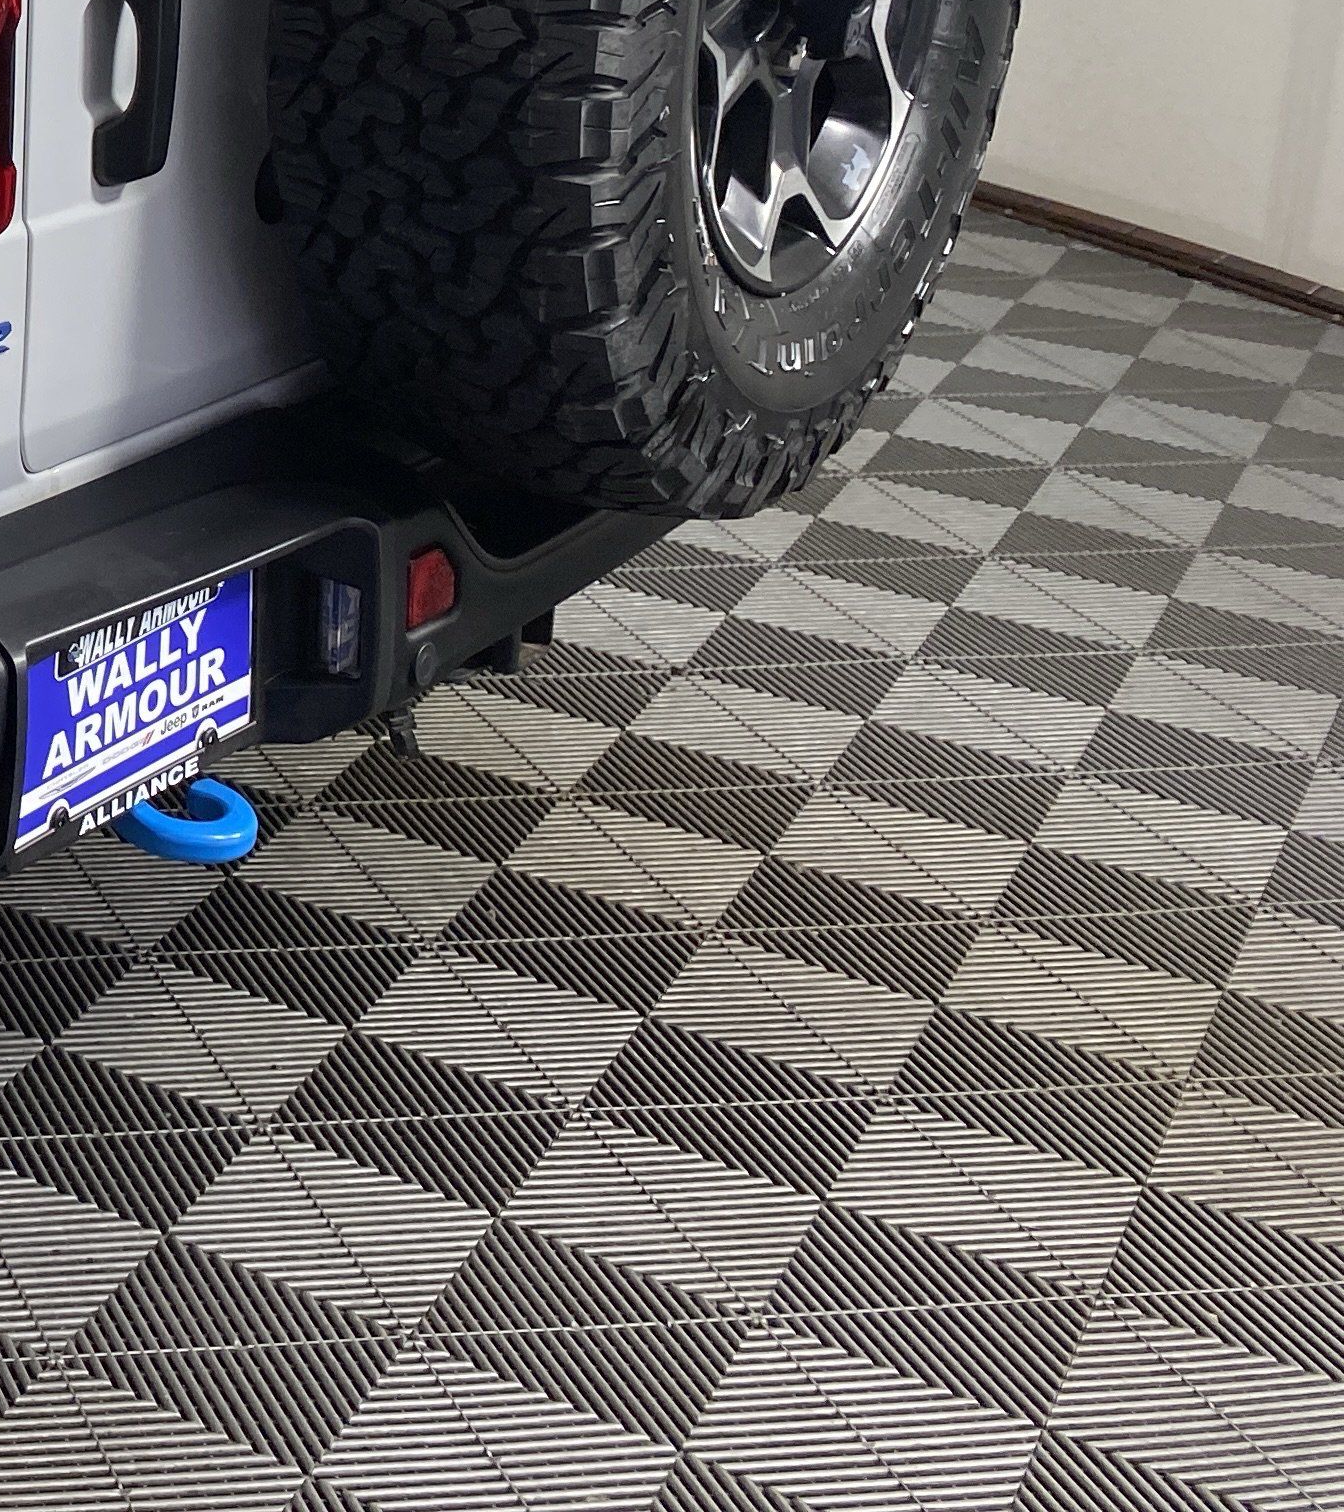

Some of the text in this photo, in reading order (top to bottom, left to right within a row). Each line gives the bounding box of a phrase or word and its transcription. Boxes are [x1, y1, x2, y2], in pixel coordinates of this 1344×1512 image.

[66, 607, 208, 717] WALLY
[76, 615, 136, 668] WALLY
[41, 647, 226, 780] ARMOUR
[159, 711, 187, 736] Jeep
[201, 694, 225, 712] RAM
[78, 755, 200, 836] ALLIANCE
